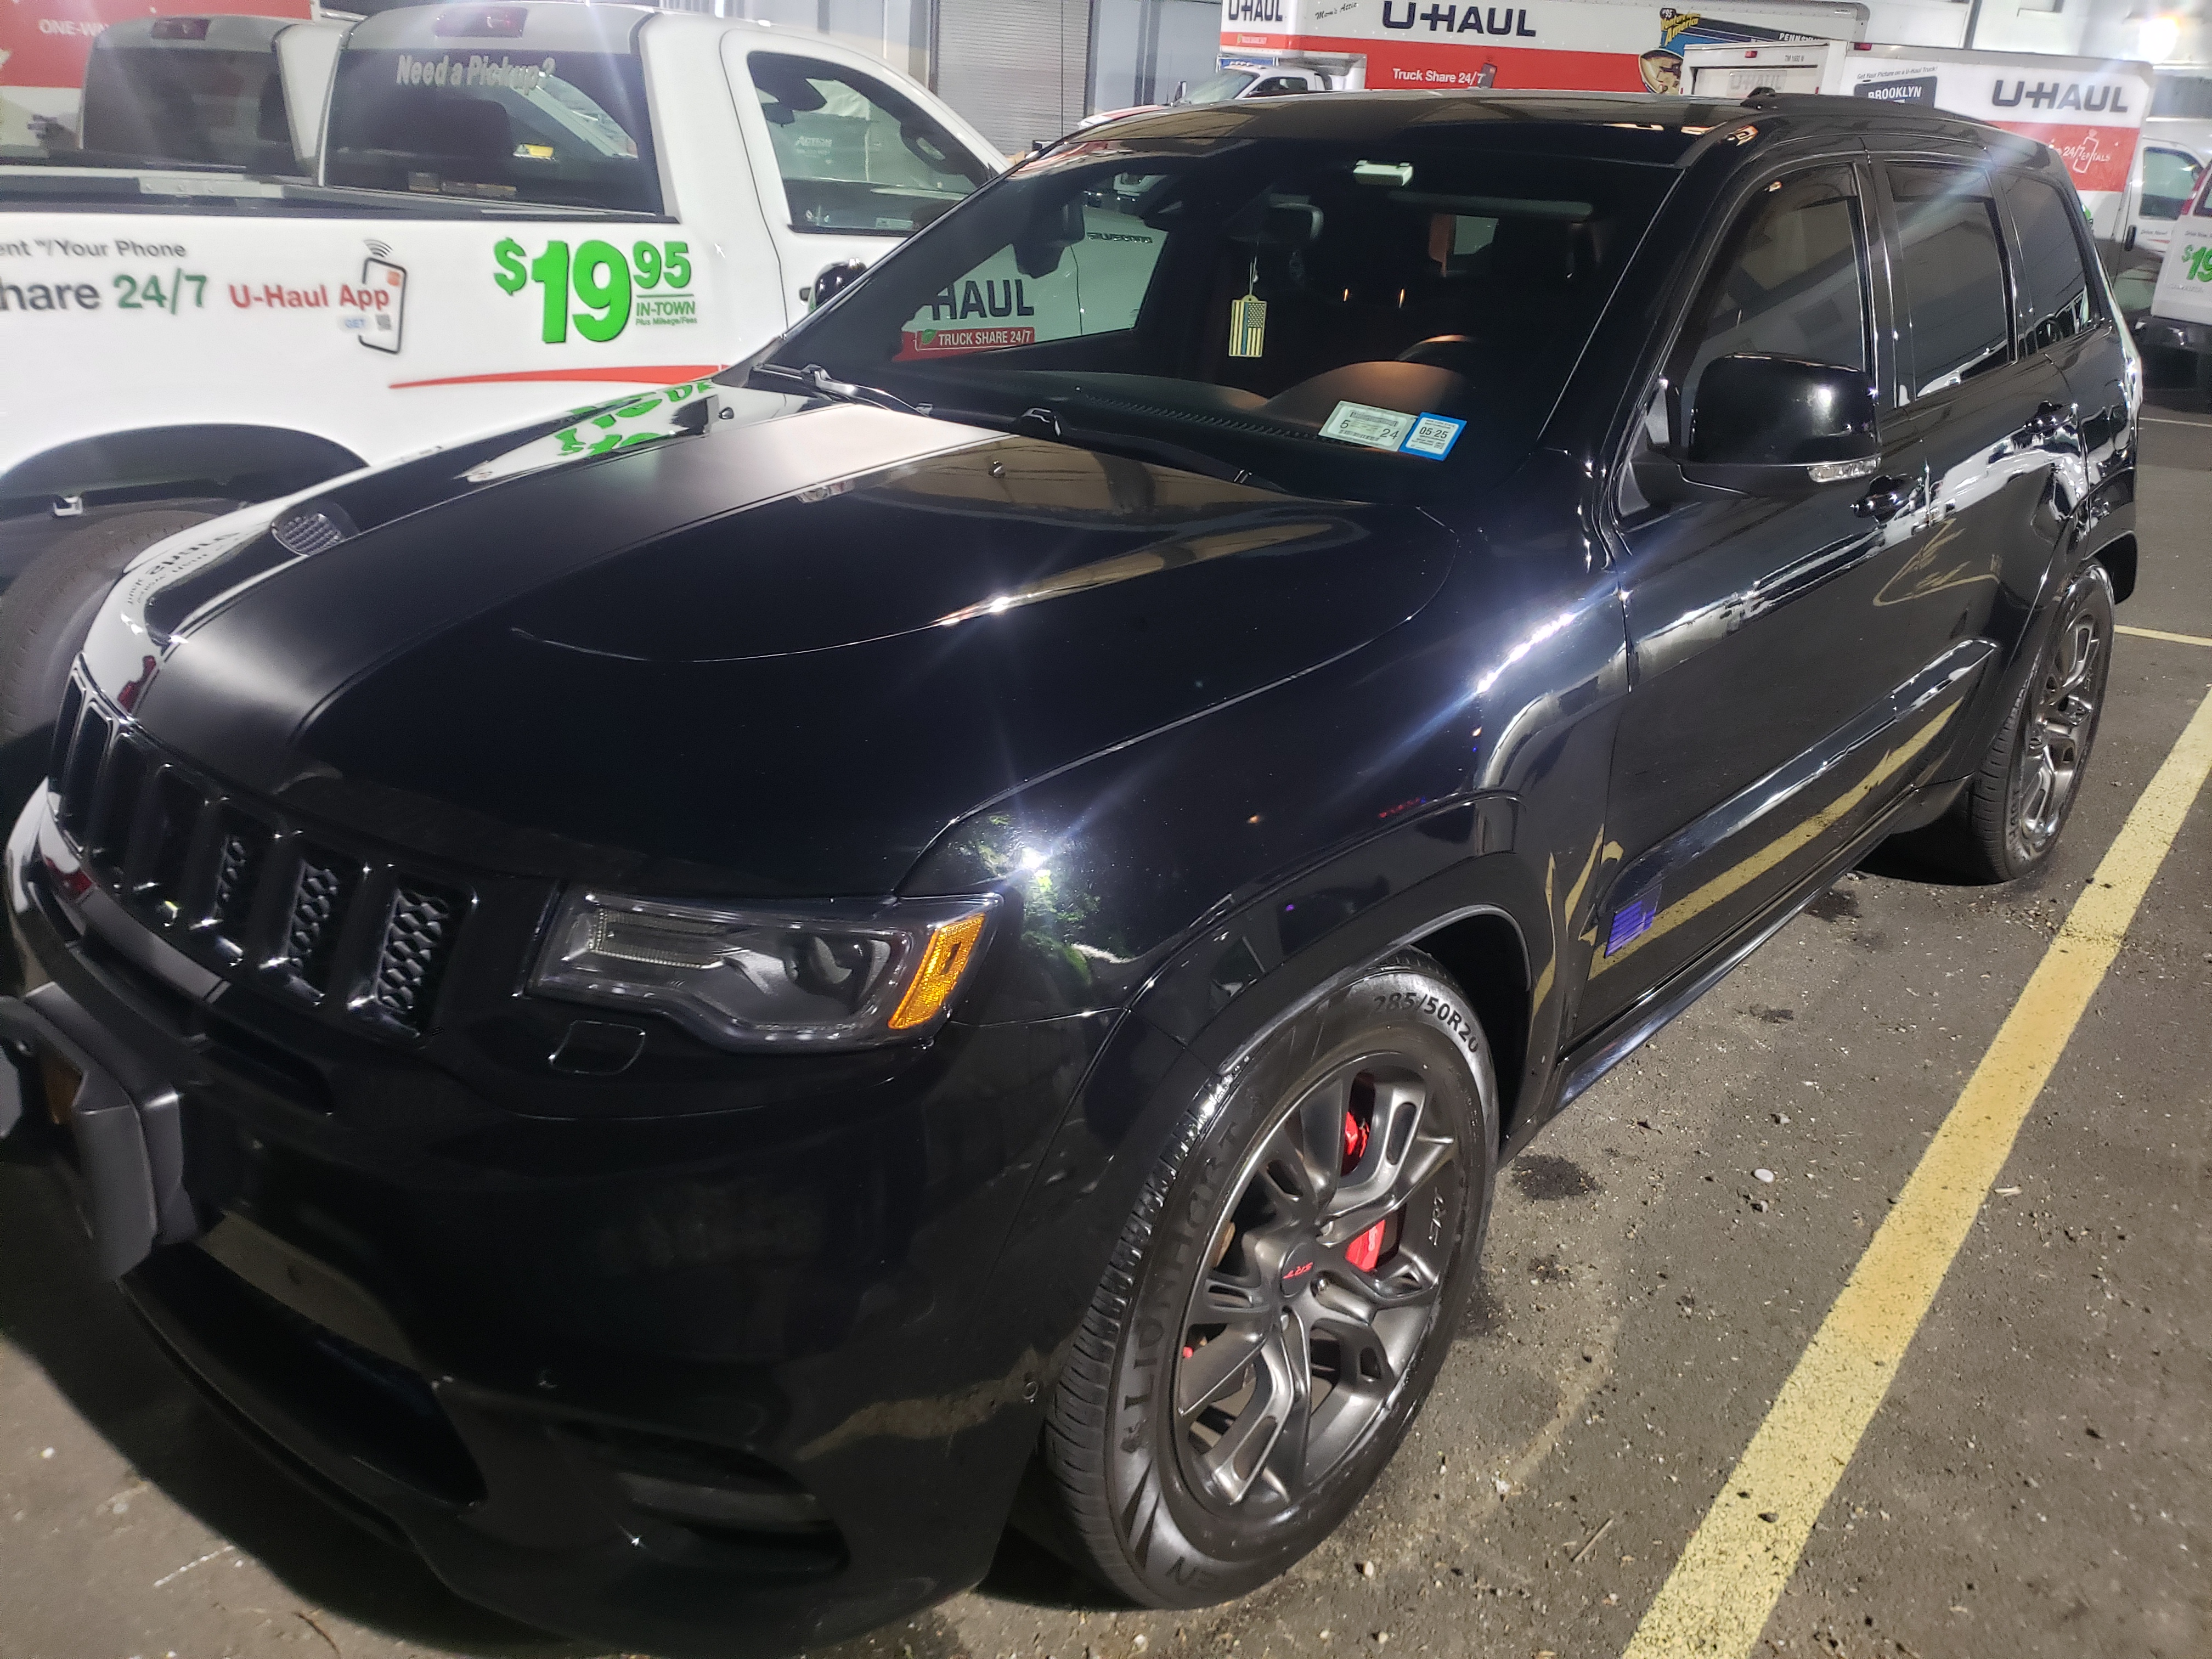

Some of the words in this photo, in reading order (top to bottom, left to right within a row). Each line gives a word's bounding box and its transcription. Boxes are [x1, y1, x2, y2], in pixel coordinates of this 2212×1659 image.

[1383, 1, 1536, 37] U-HAUL
[396, 55, 449, 87] Need
[450, 62, 464, 86] a
[466, 55, 556, 96] Pickup?
[1393, 68, 1423, 82] Truck
[1425, 70, 1457, 83] Share
[1458, 71, 1486, 86] 24/7
[1991, 80, 2130, 113] U-HAUL
[115, 240, 187, 257] Phone
[114, 267, 207, 315] 24/7
[228, 284, 330, 309] U-Haul
[339, 283, 390, 312] App
[636, 301, 696, 317] IN-TOWN
[938, 333, 973, 346] TRUCK
[975, 331, 1008, 345] SHARE
[1009, 329, 1032, 343] 24/7
[1339, 419, 1351, 429] 5
[1379, 428, 1400, 440] 24
[1374, 992, 1479, 1053] 285/50R20
